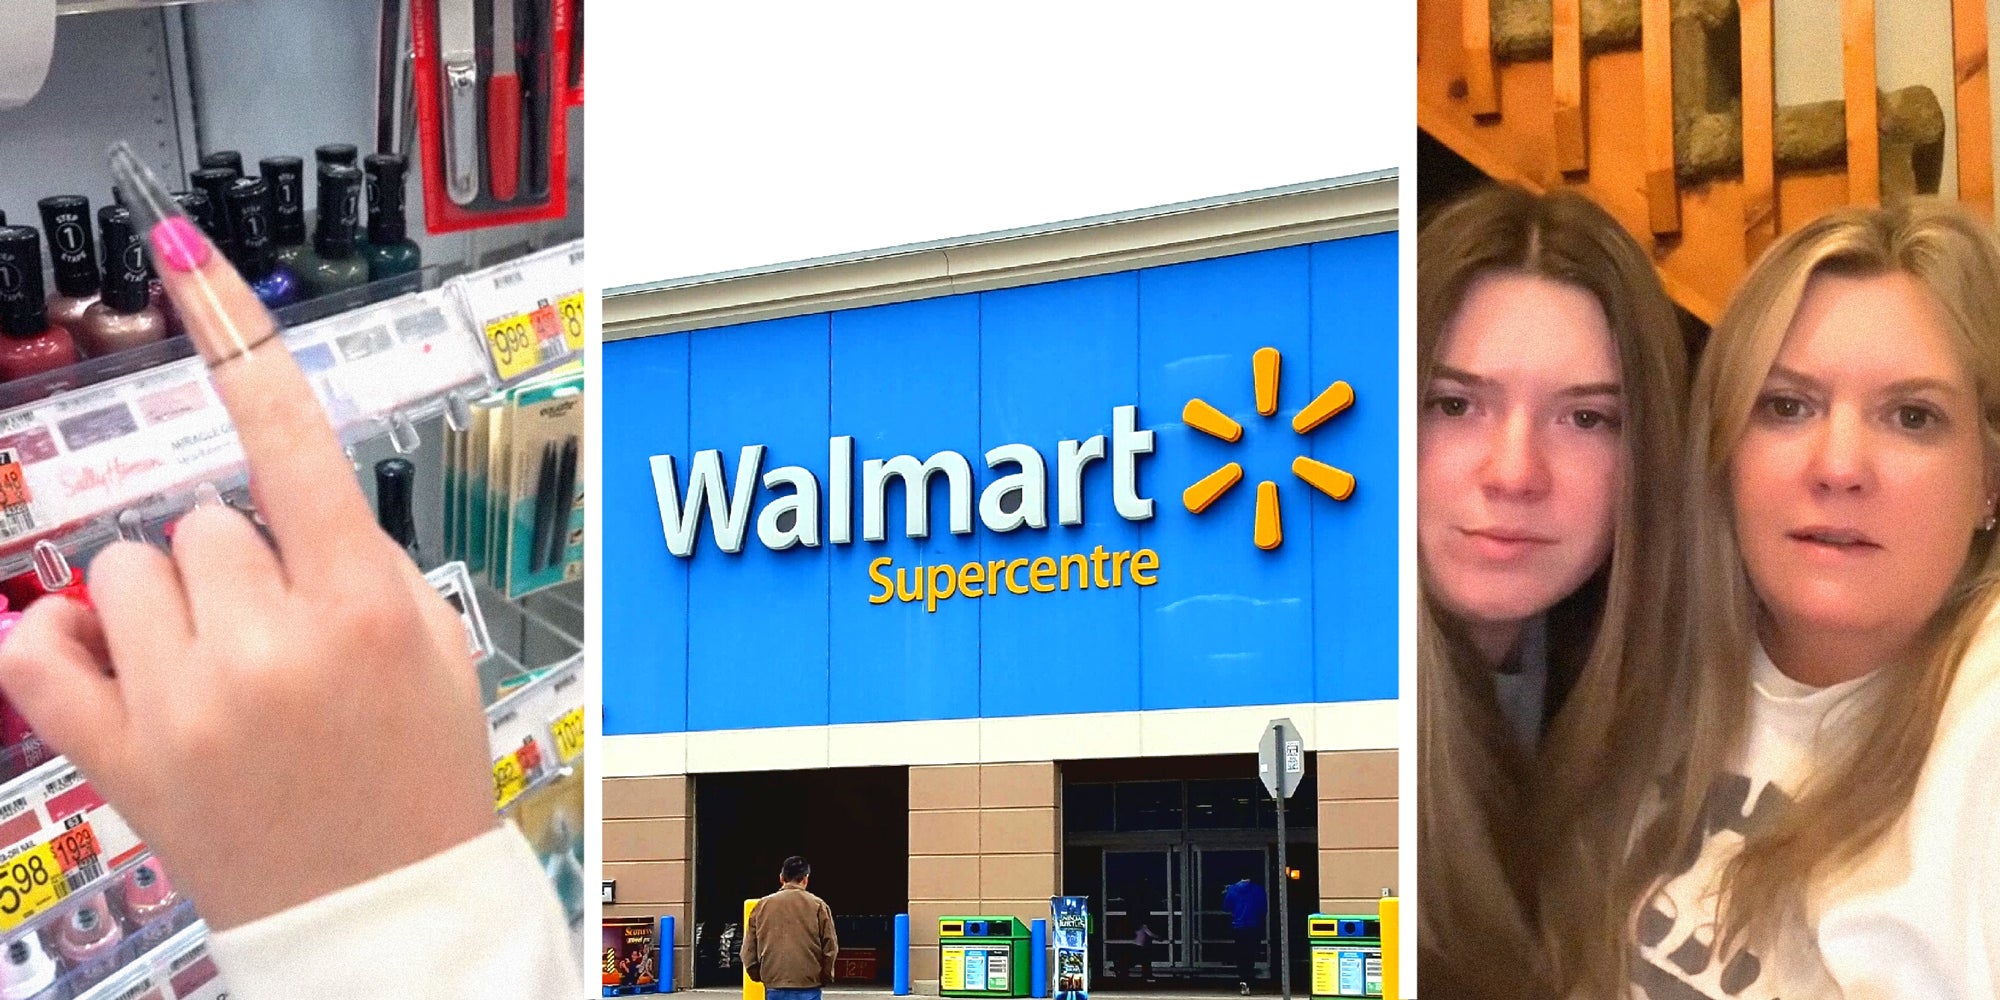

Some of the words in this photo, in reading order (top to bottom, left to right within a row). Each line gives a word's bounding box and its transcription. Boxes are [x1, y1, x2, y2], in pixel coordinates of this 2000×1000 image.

[282, 185, 290, 202] 1
[56, 213, 78, 223] STEP
[248, 216, 258, 235] 1
[63, 227, 75, 249] 1
[60, 250, 87, 262] ETAPE
[133, 247, 143, 268] 1
[123, 270, 147, 281] ETAP
[494, 323, 529, 365] 998
[649, 405, 1155, 558] Walmart
[869, 545, 1160, 613] Supercentre
